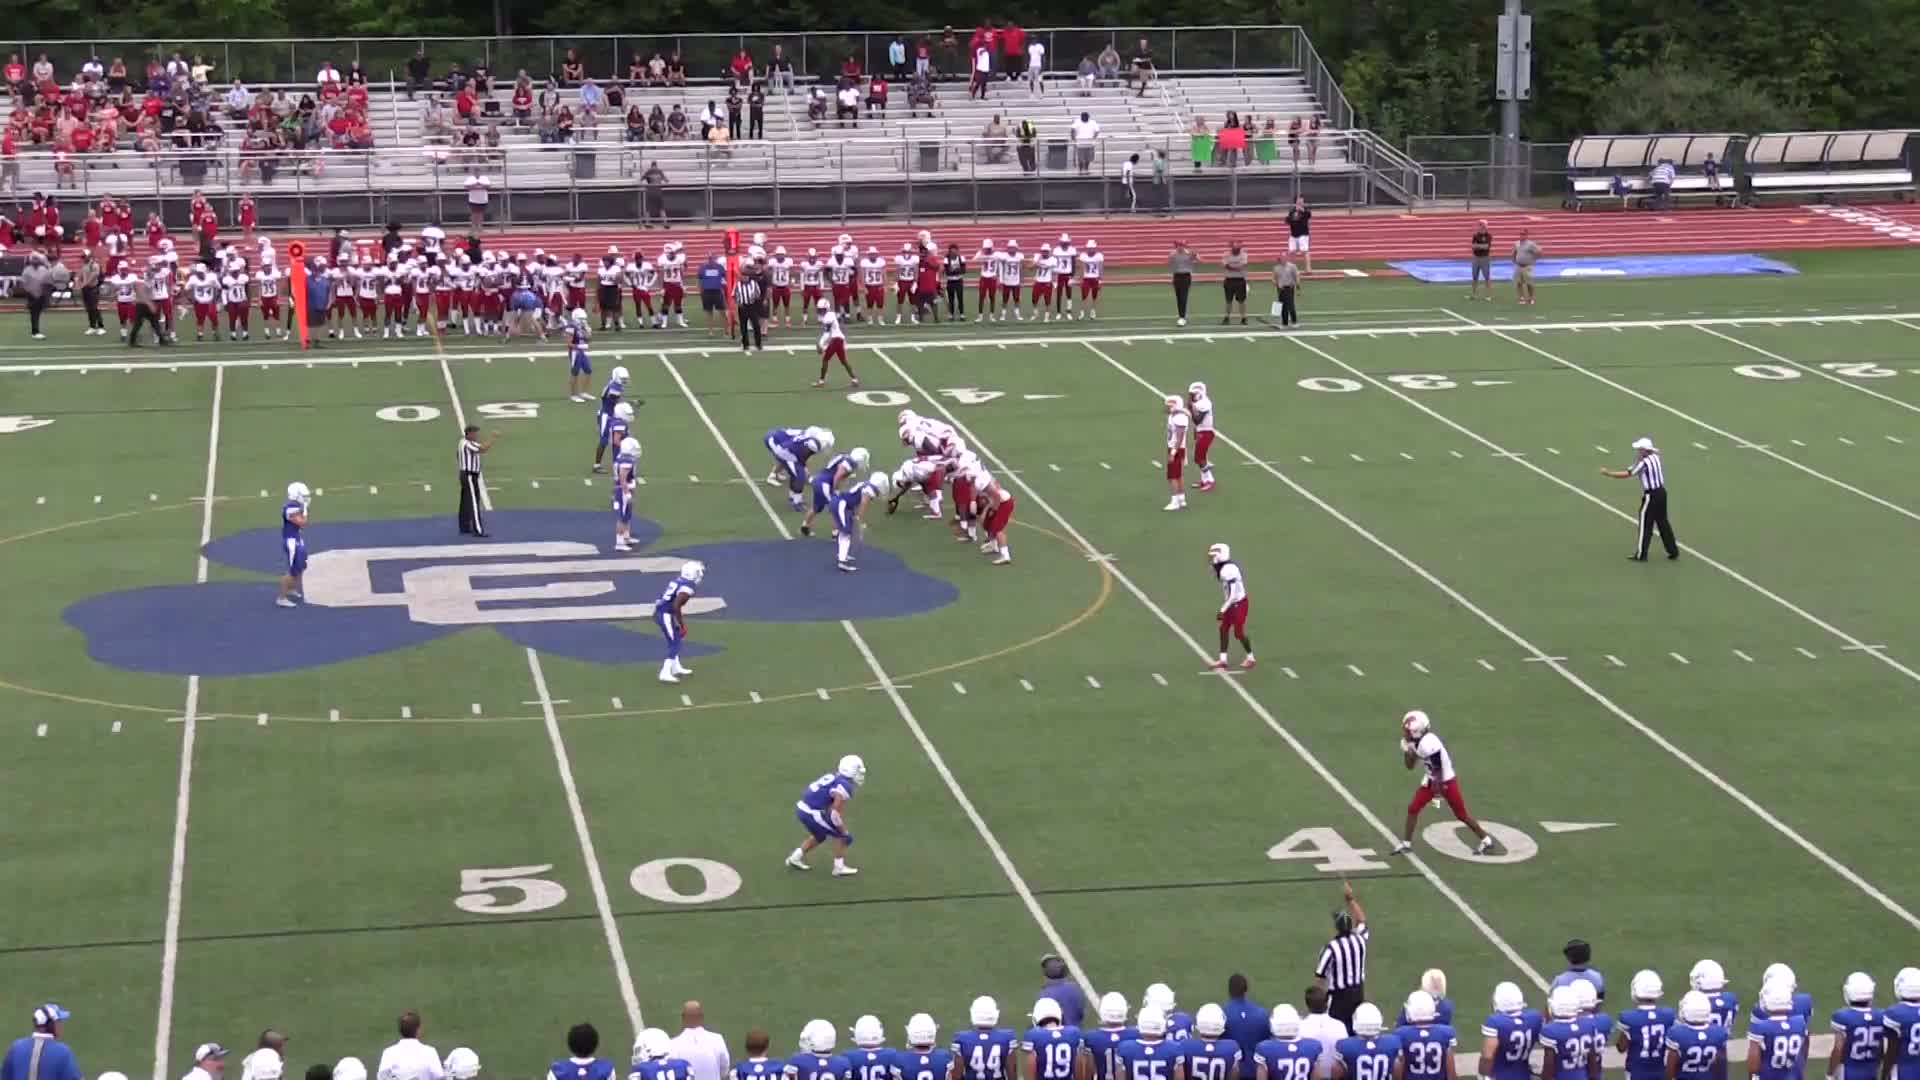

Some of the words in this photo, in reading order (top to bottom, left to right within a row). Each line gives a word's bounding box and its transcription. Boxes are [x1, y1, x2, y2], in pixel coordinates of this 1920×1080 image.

[1506, 1029, 1532, 1061] 31
[1640, 1023, 1666, 1058] 17
[970, 1045, 1001, 1079] 44
[1044, 1043, 1072, 1078] 19
[1192, 1056, 1226, 1080] 50
[1409, 1041, 1442, 1074] 33
